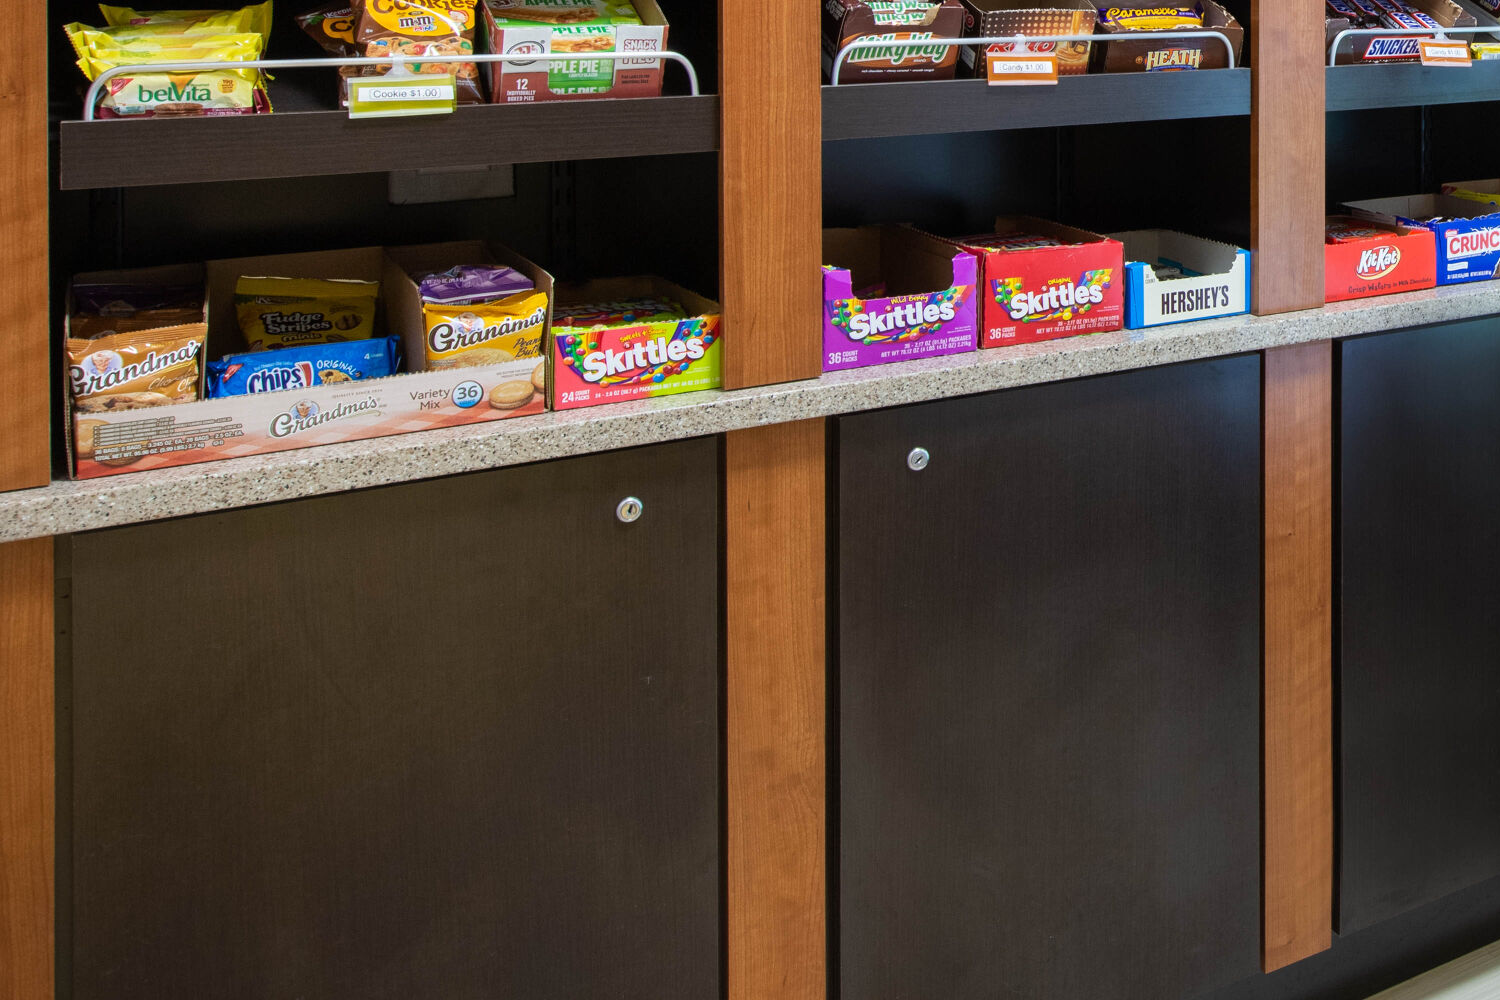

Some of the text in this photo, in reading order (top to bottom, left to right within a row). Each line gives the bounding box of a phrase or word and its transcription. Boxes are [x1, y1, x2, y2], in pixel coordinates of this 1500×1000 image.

[1105, 7, 1178, 19] Caramello
[588, 26, 609, 34] PIE
[624, 39, 657, 51] SNACK
[1146, 49, 1202, 69] HEATH
[579, 60, 599, 73] PIE
[1002, 63, 1045, 73] Candy $1.00
[138, 79, 212, 103] belVita
[516, 79, 528, 90] 12
[373, 88, 438, 99] Cookie $1.00
[1357, 248, 1397, 274] KitKat
[1348, 285, 1367, 294] Crisp
[1368, 282, 1391, 291] Wafers
[1010, 282, 1104, 319] Skittles
[1161, 285, 1230, 315] HERSHEY'S
[262, 311, 325, 327] Fudge
[849, 302, 955, 340] Skittles
[266, 320, 333, 335] Stripes
[428, 311, 546, 353] Grandma's
[989, 328, 1001, 340] 36
[583, 337, 705, 382] Skittles
[828, 352, 842, 364] 36
[316, 360, 363, 379] ORIGINAL
[410, 388, 450, 401] Variety
[457, 386, 478, 399] 36
[562, 391, 574, 403] 24
[420, 399, 440, 411] Mix
[270, 397, 378, 438] Grandma's
